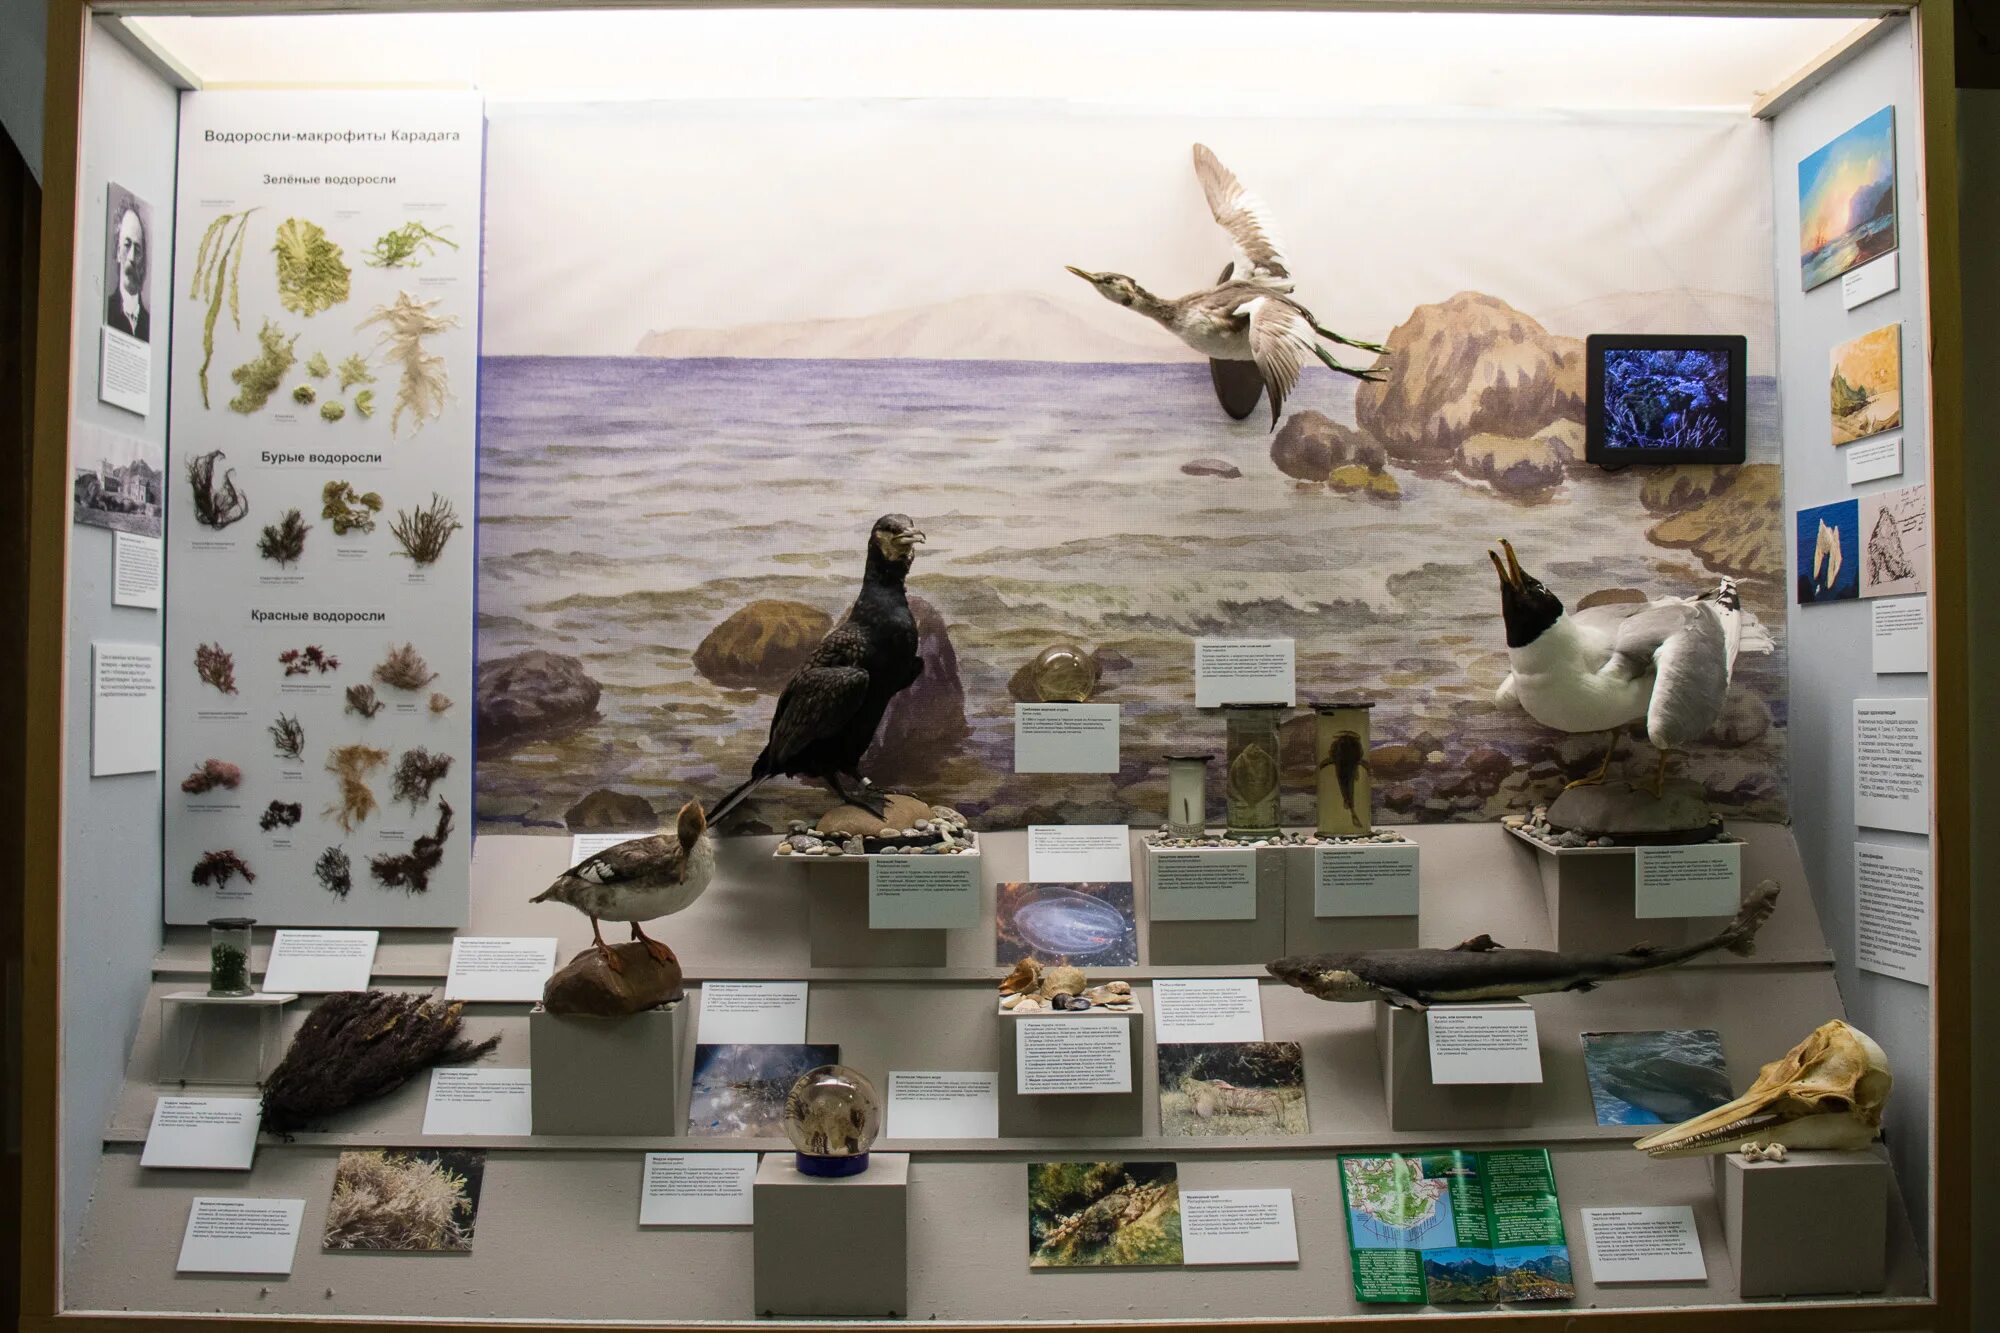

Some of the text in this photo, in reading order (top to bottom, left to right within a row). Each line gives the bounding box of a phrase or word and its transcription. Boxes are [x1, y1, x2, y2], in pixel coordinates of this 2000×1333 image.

[204, 129, 460, 144] Водоросли-макрофиты Карадага
[263, 173, 396, 187] Зелёные водоросли
[261, 451, 382, 466] Бурые водоросли
[251, 609, 386, 625] Красные водоросли
